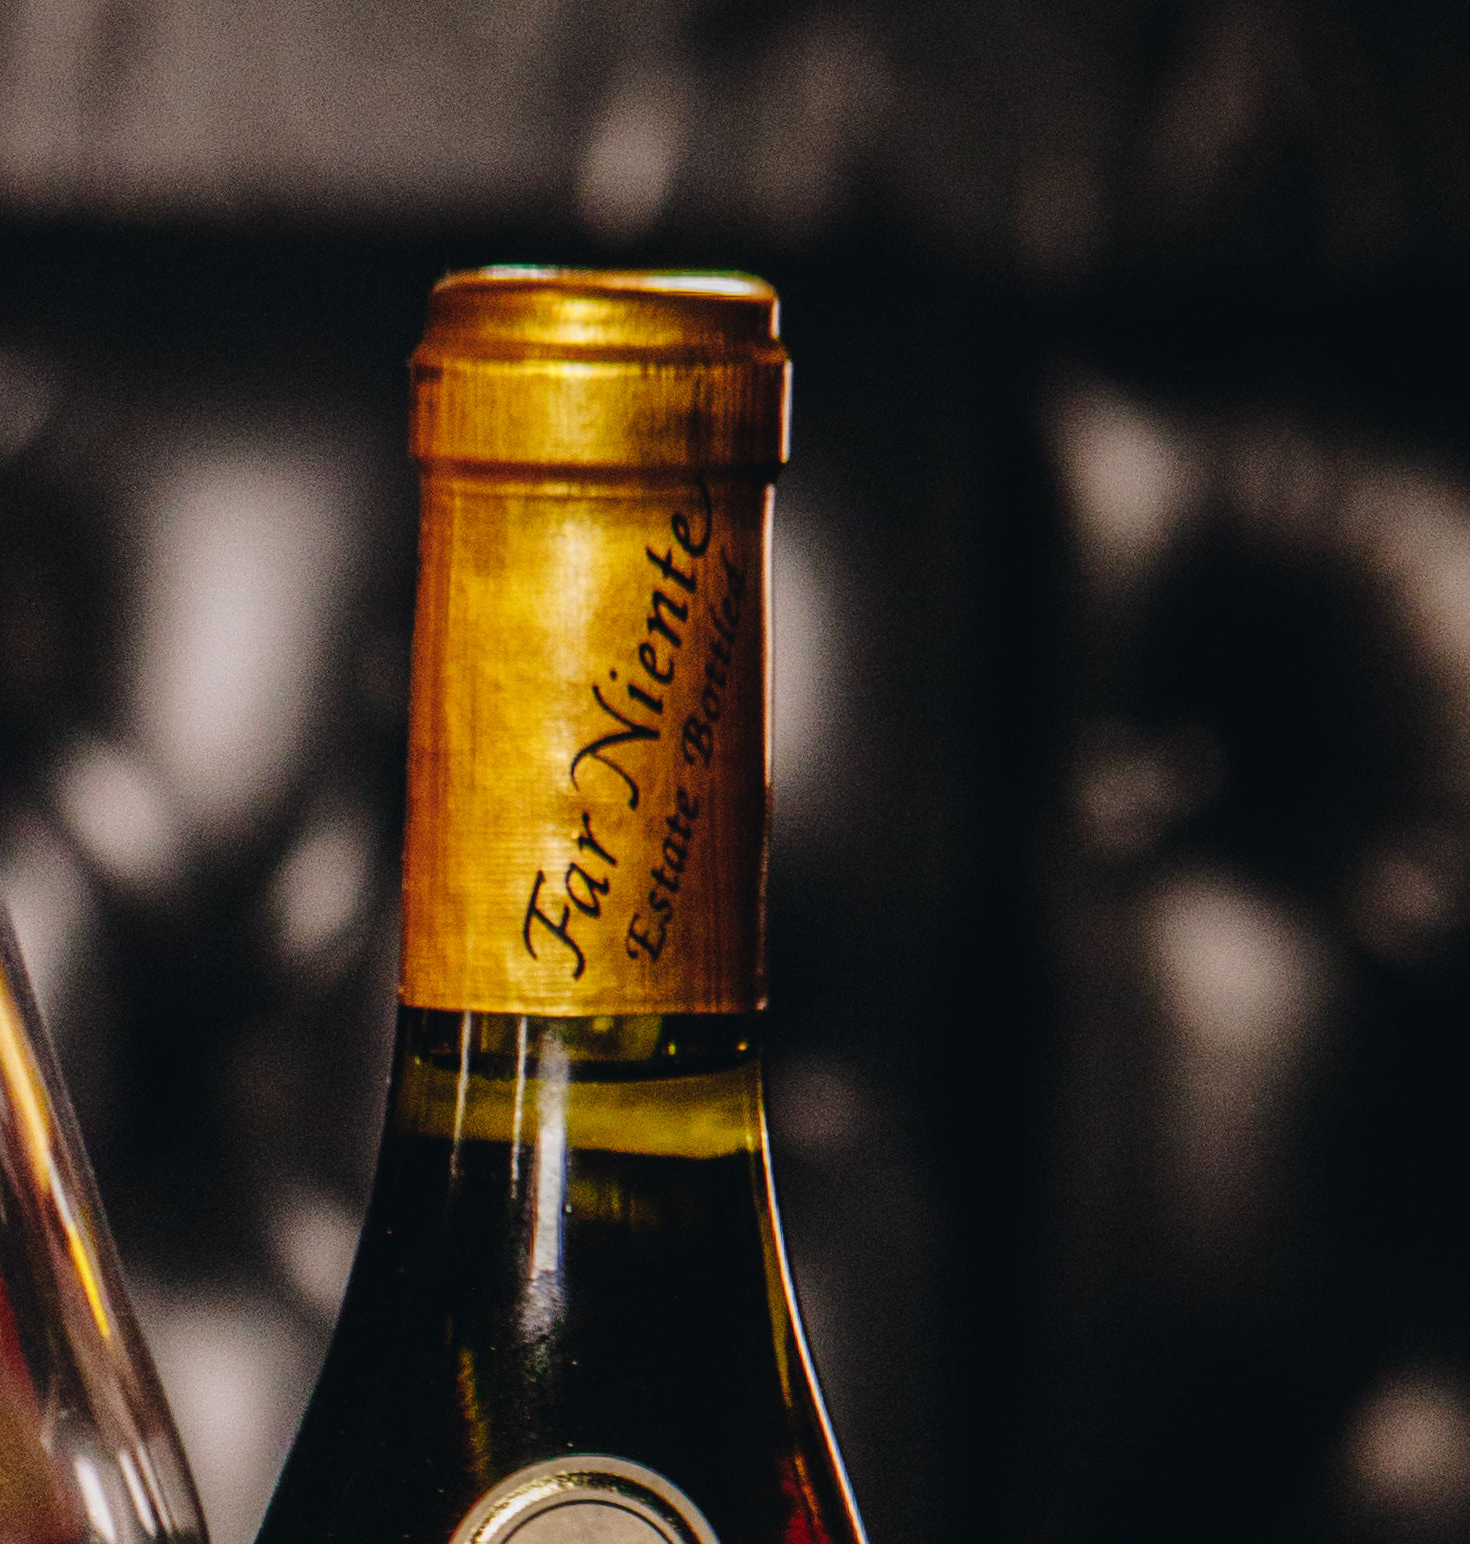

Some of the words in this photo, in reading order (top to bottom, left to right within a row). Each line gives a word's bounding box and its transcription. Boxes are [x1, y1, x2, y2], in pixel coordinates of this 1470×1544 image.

[522, 812, 617, 980] Far
[571, 478, 711, 811] Niente
[626, 790, 698, 963] Estate
